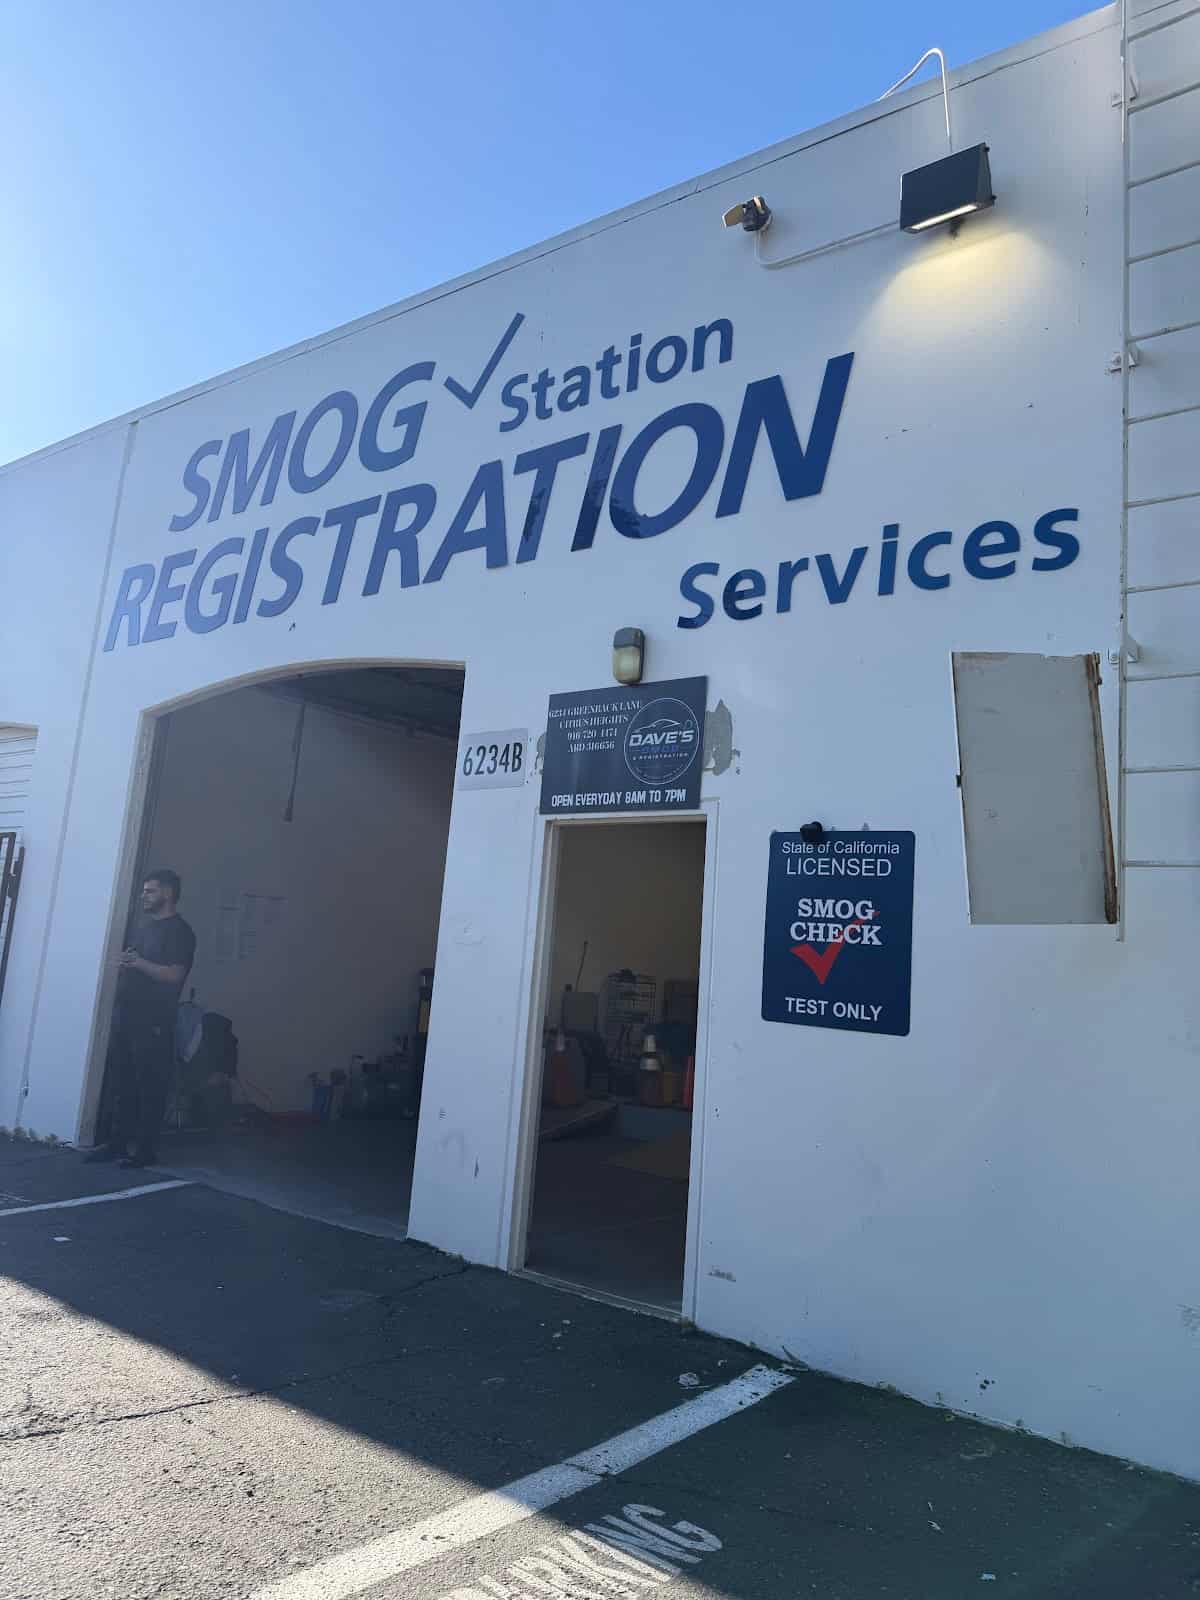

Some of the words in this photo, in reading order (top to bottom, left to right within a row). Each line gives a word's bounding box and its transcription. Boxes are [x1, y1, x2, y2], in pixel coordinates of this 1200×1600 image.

[168, 361, 437, 532] SMOG
[499, 317, 734, 432] Station
[103, 351, 854, 652] REGISTRATION
[677, 508, 1080, 629] Services
[629, 729, 694, 747] DAVE'S
[463, 742, 523, 777] 6234B
[551, 793, 574, 808] OPEN
[575, 791, 623, 807] EVERYDAY
[625, 790, 646, 804] 8AM
[649, 789, 662, 803] TO
[664, 788, 687, 802] 7PM
[782, 841, 814, 855] State
[817, 841, 832, 854] of
[833, 840, 900, 856] California
[786, 857, 892, 877] LICENSED
[797, 898, 875, 921] SMOG
[790, 921, 883, 946] CHECK
[785, 997, 828, 1016] TEST
[832, 1002, 883, 1022] ONLY
